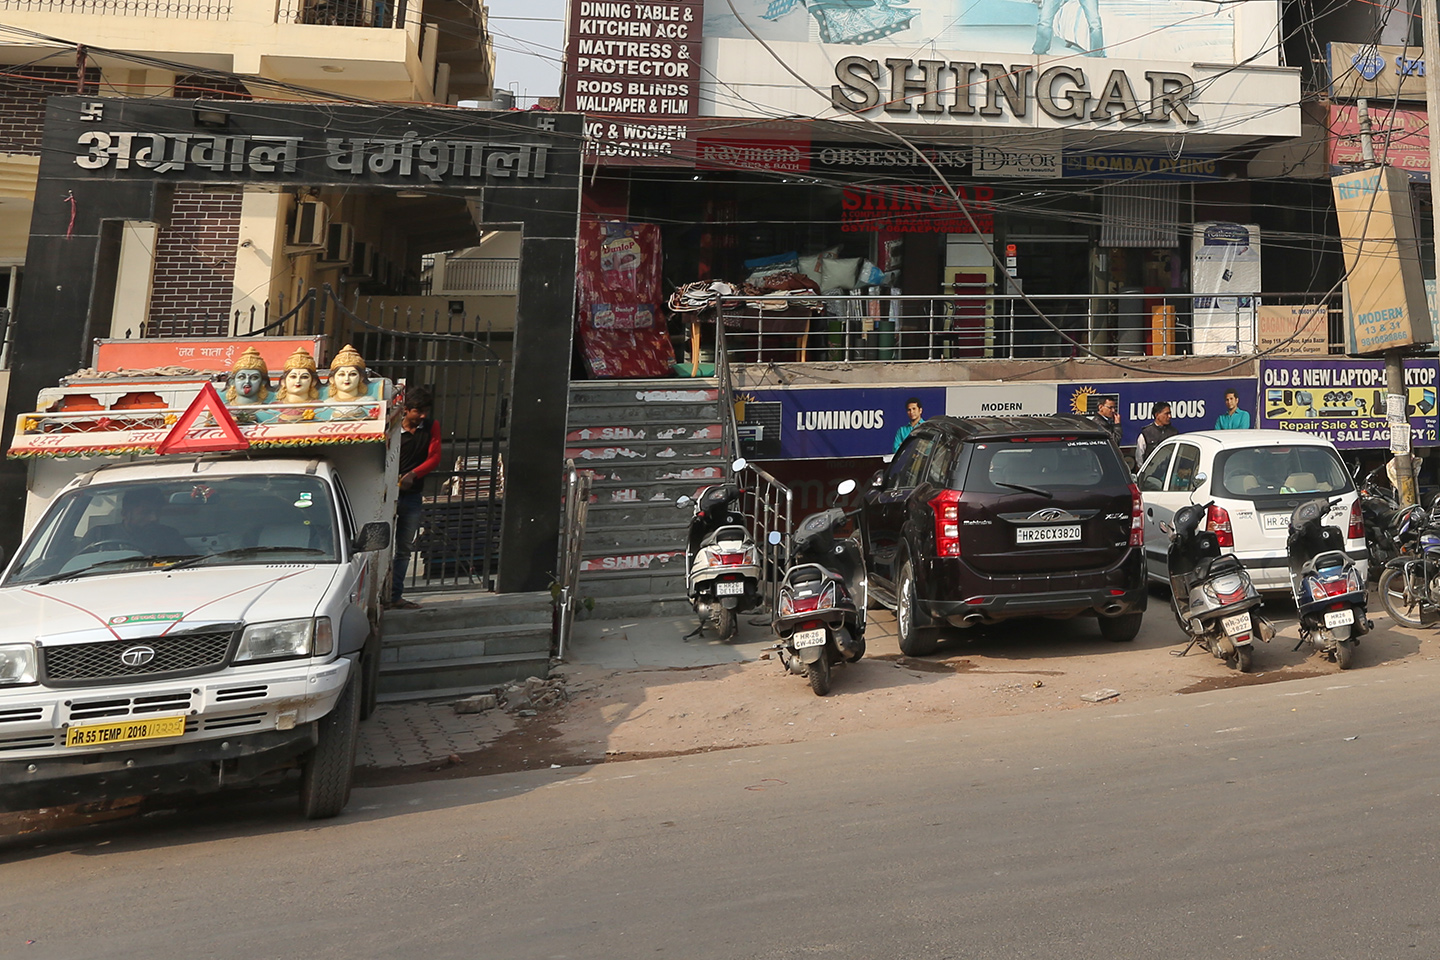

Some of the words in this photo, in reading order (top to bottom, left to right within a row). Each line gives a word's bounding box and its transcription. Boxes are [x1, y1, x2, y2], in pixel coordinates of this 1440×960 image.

[581, 2, 632, 19] DINING
[636, 5, 679, 21] TABLE
[580, 19, 651, 37] KITCHEN
[655, 23, 687, 39] ACC
[579, 40, 672, 59] MATTRESS
[578, 58, 689, 78] PROTECTOR
[577, 80, 621, 95] RODS
[629, 82, 689, 96] BLINDS
[831, 55, 1199, 126] SHINGAR
[576, 96, 645, 112] WALLPAPER
[661, 100, 688, 114] FILM
[624, 125, 686, 140] WOODEN
[76, 131, 302, 174] अग्रवाल
[326, 131, 553, 182] धर्मशाला
[586, 140, 672, 157] FLOORING
[1086, 156, 1154, 172] BOMBAY
[1159, 158, 1216, 174] DYEING
[1338, 175, 1383, 200] REPAIR
[1358, 307, 1402, 325] MODERN
[1265, 369, 1289, 386] OLD
[1291, 369, 1301, 385] &
[1303, 369, 1330, 386] NEW
[981, 402, 1022, 411] MODERN
[797, 410, 884, 431] LUMINOUS
[1279, 422, 1319, 430] Repair
[1338, 431, 1371, 441] SALE
[1426, 430, 1436, 440] 12
[1023, 528, 1080, 540] HR26CX3820
[72, 731, 83, 744] HR
[86, 731, 96, 742] 55
[99, 728, 121, 741] TEMP
[128, 725, 146, 738] 2018
